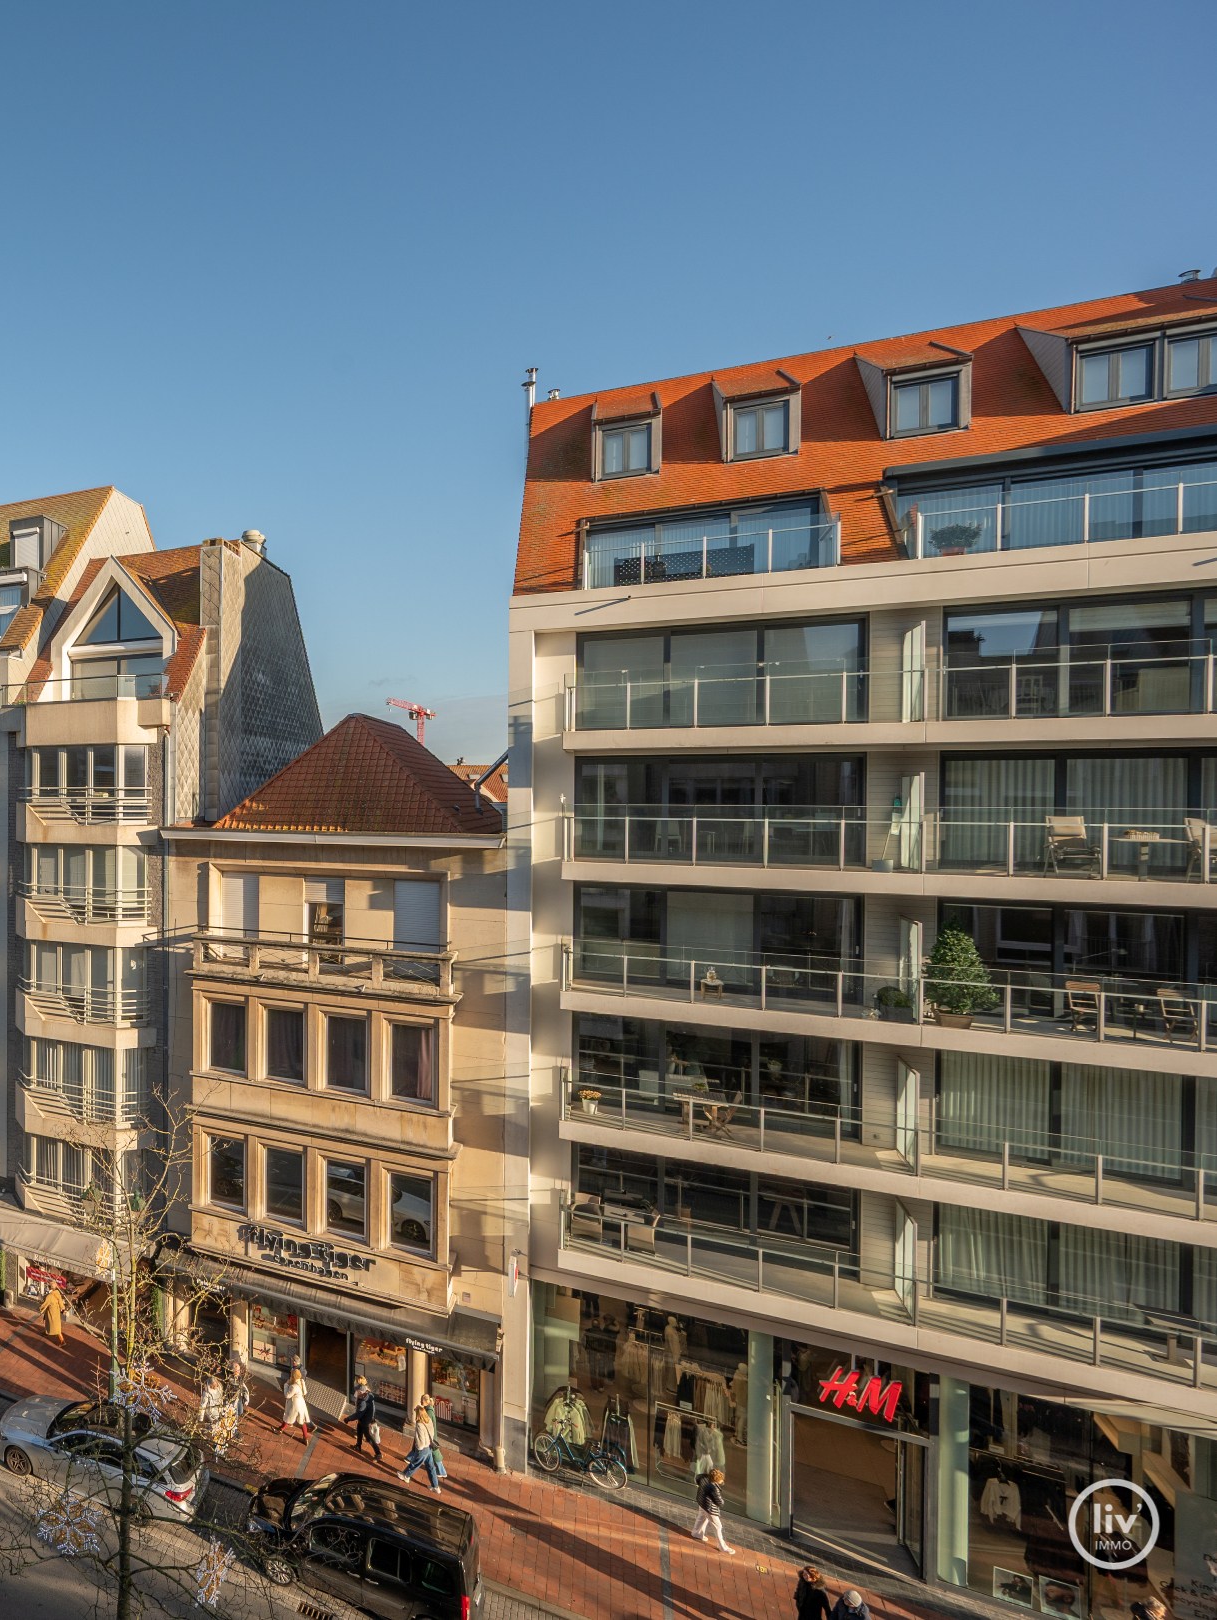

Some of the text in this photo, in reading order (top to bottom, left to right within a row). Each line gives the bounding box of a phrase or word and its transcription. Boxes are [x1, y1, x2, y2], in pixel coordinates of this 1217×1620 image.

[34, 1254, 61, 1267] REGATTA
[316, 1243, 376, 1271] tiger
[425, 1343, 443, 1353] tiger
[819, 1366, 903, 1423] H&M
